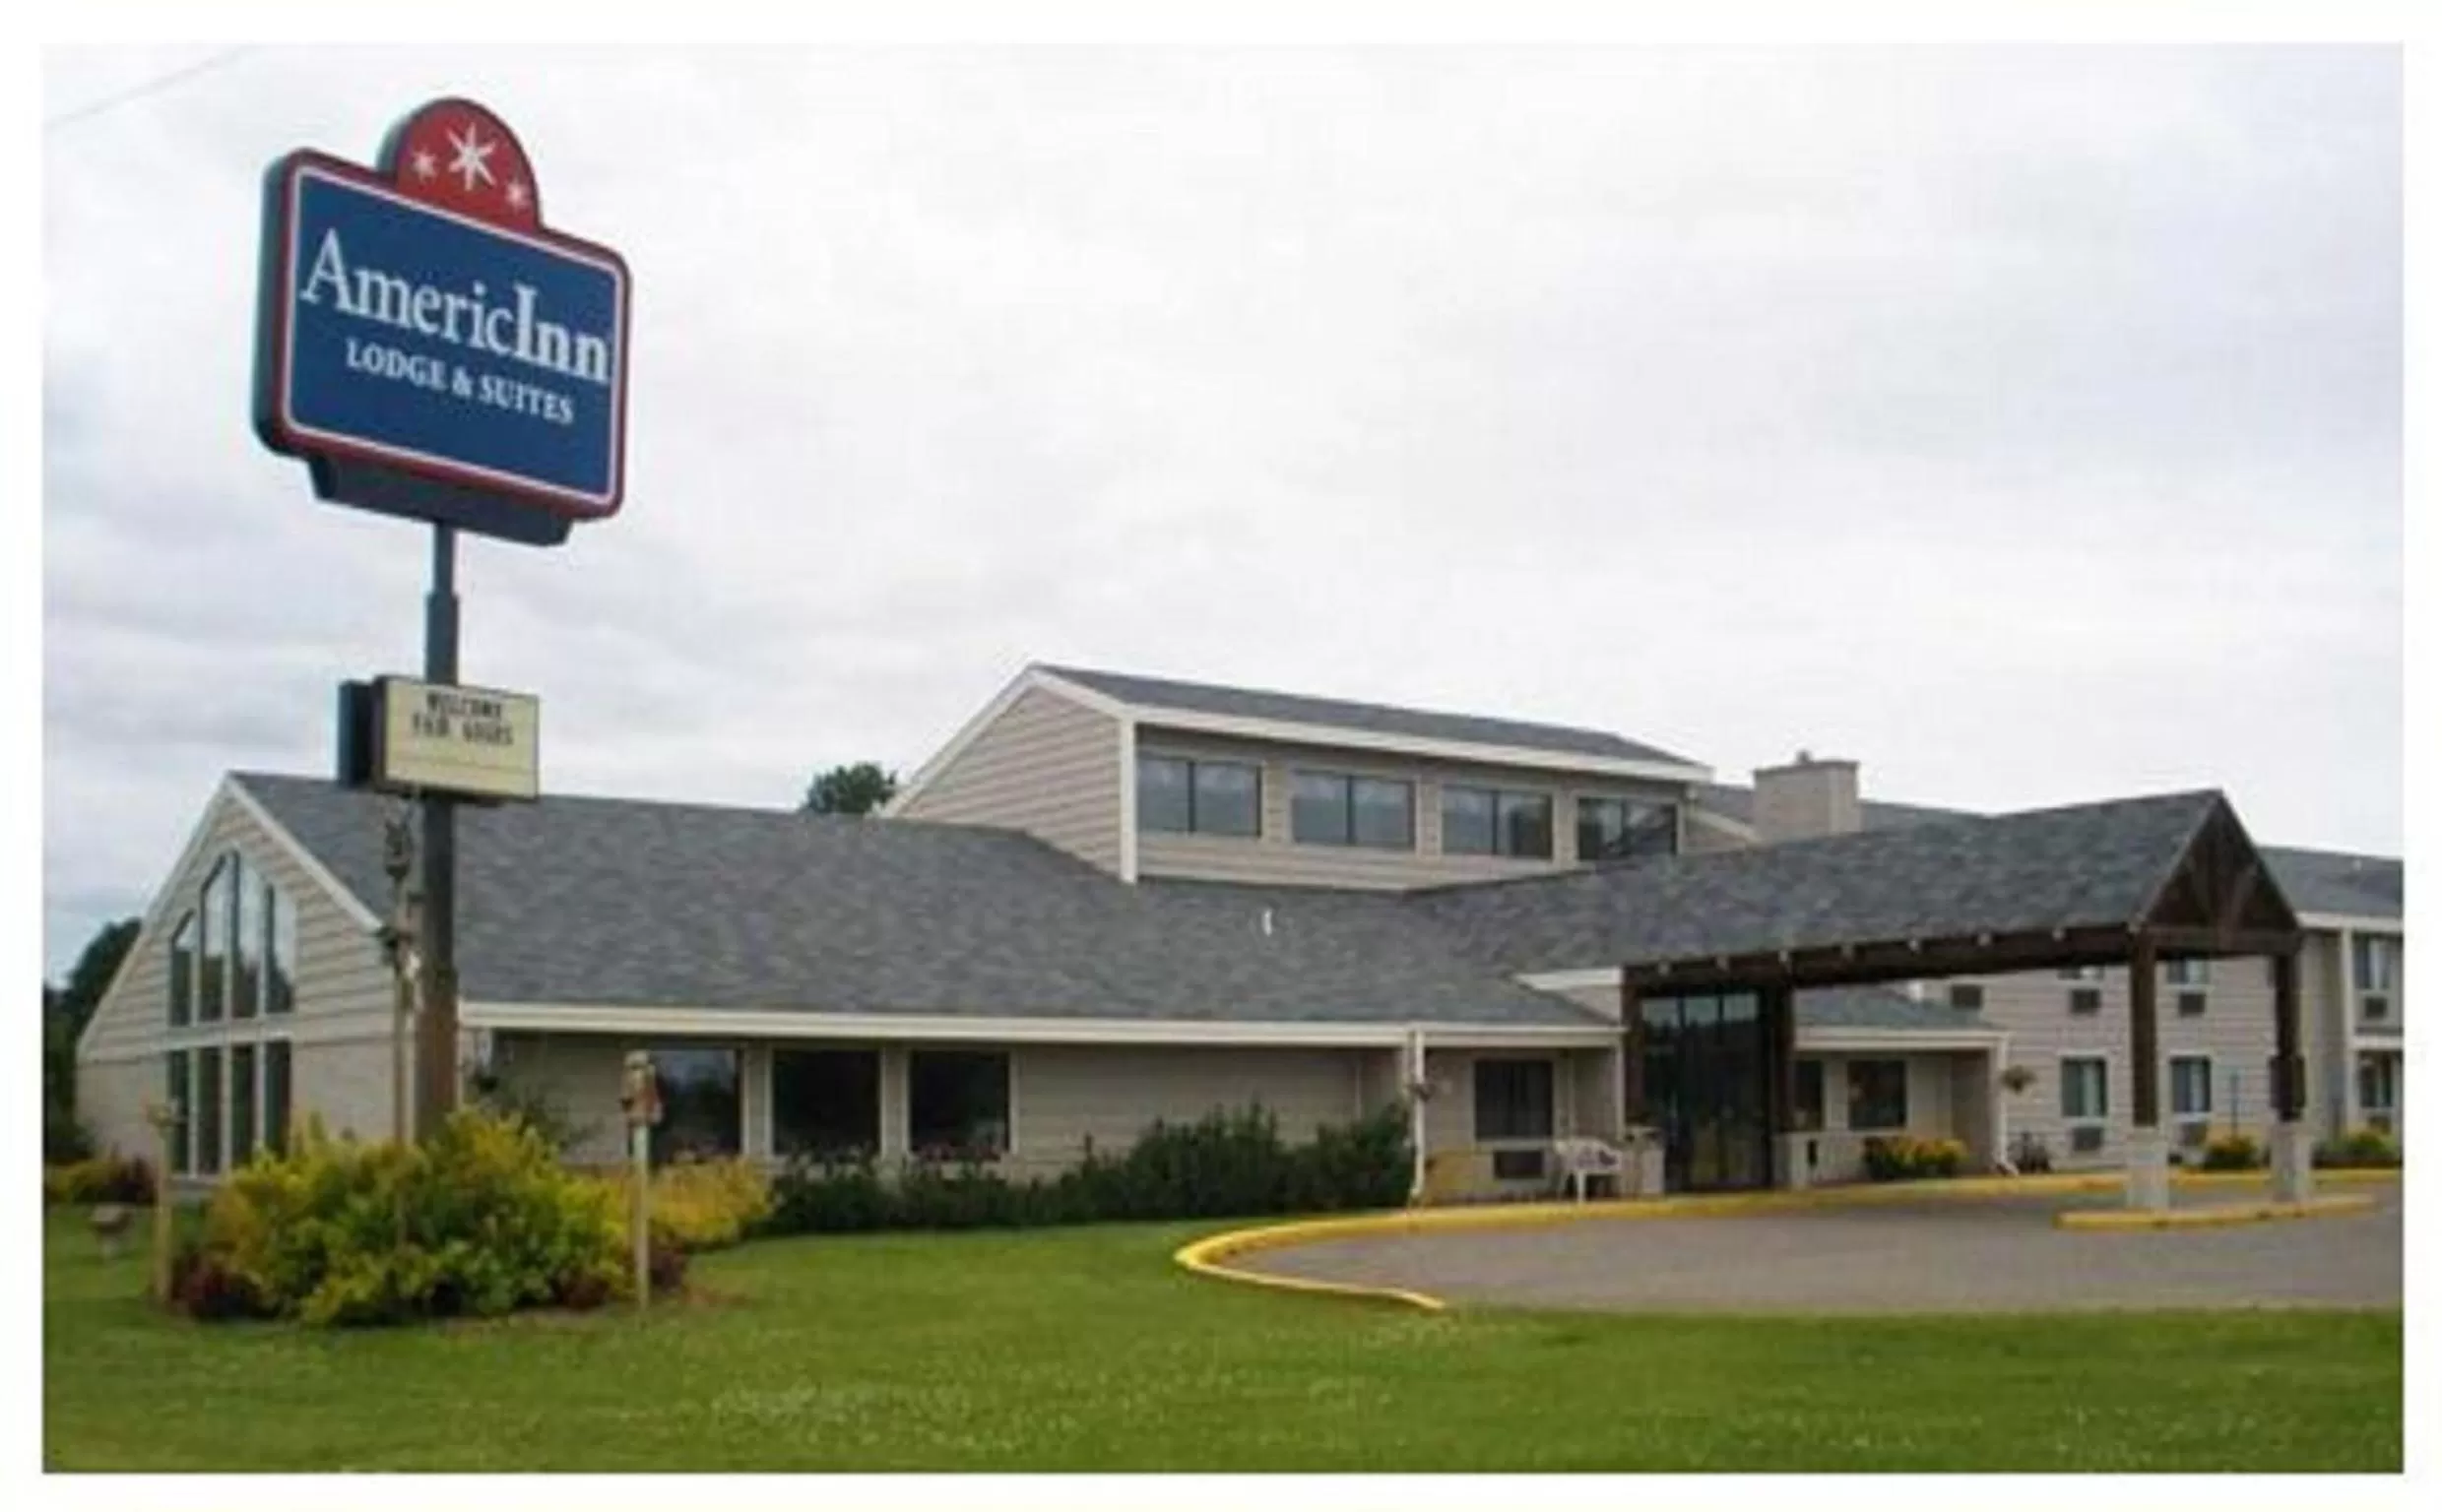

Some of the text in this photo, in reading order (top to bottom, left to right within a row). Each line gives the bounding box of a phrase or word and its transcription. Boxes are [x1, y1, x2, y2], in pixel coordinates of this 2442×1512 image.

[299, 227, 611, 384] AmericInn
[347, 338, 575, 424] LODGE & SUITES
